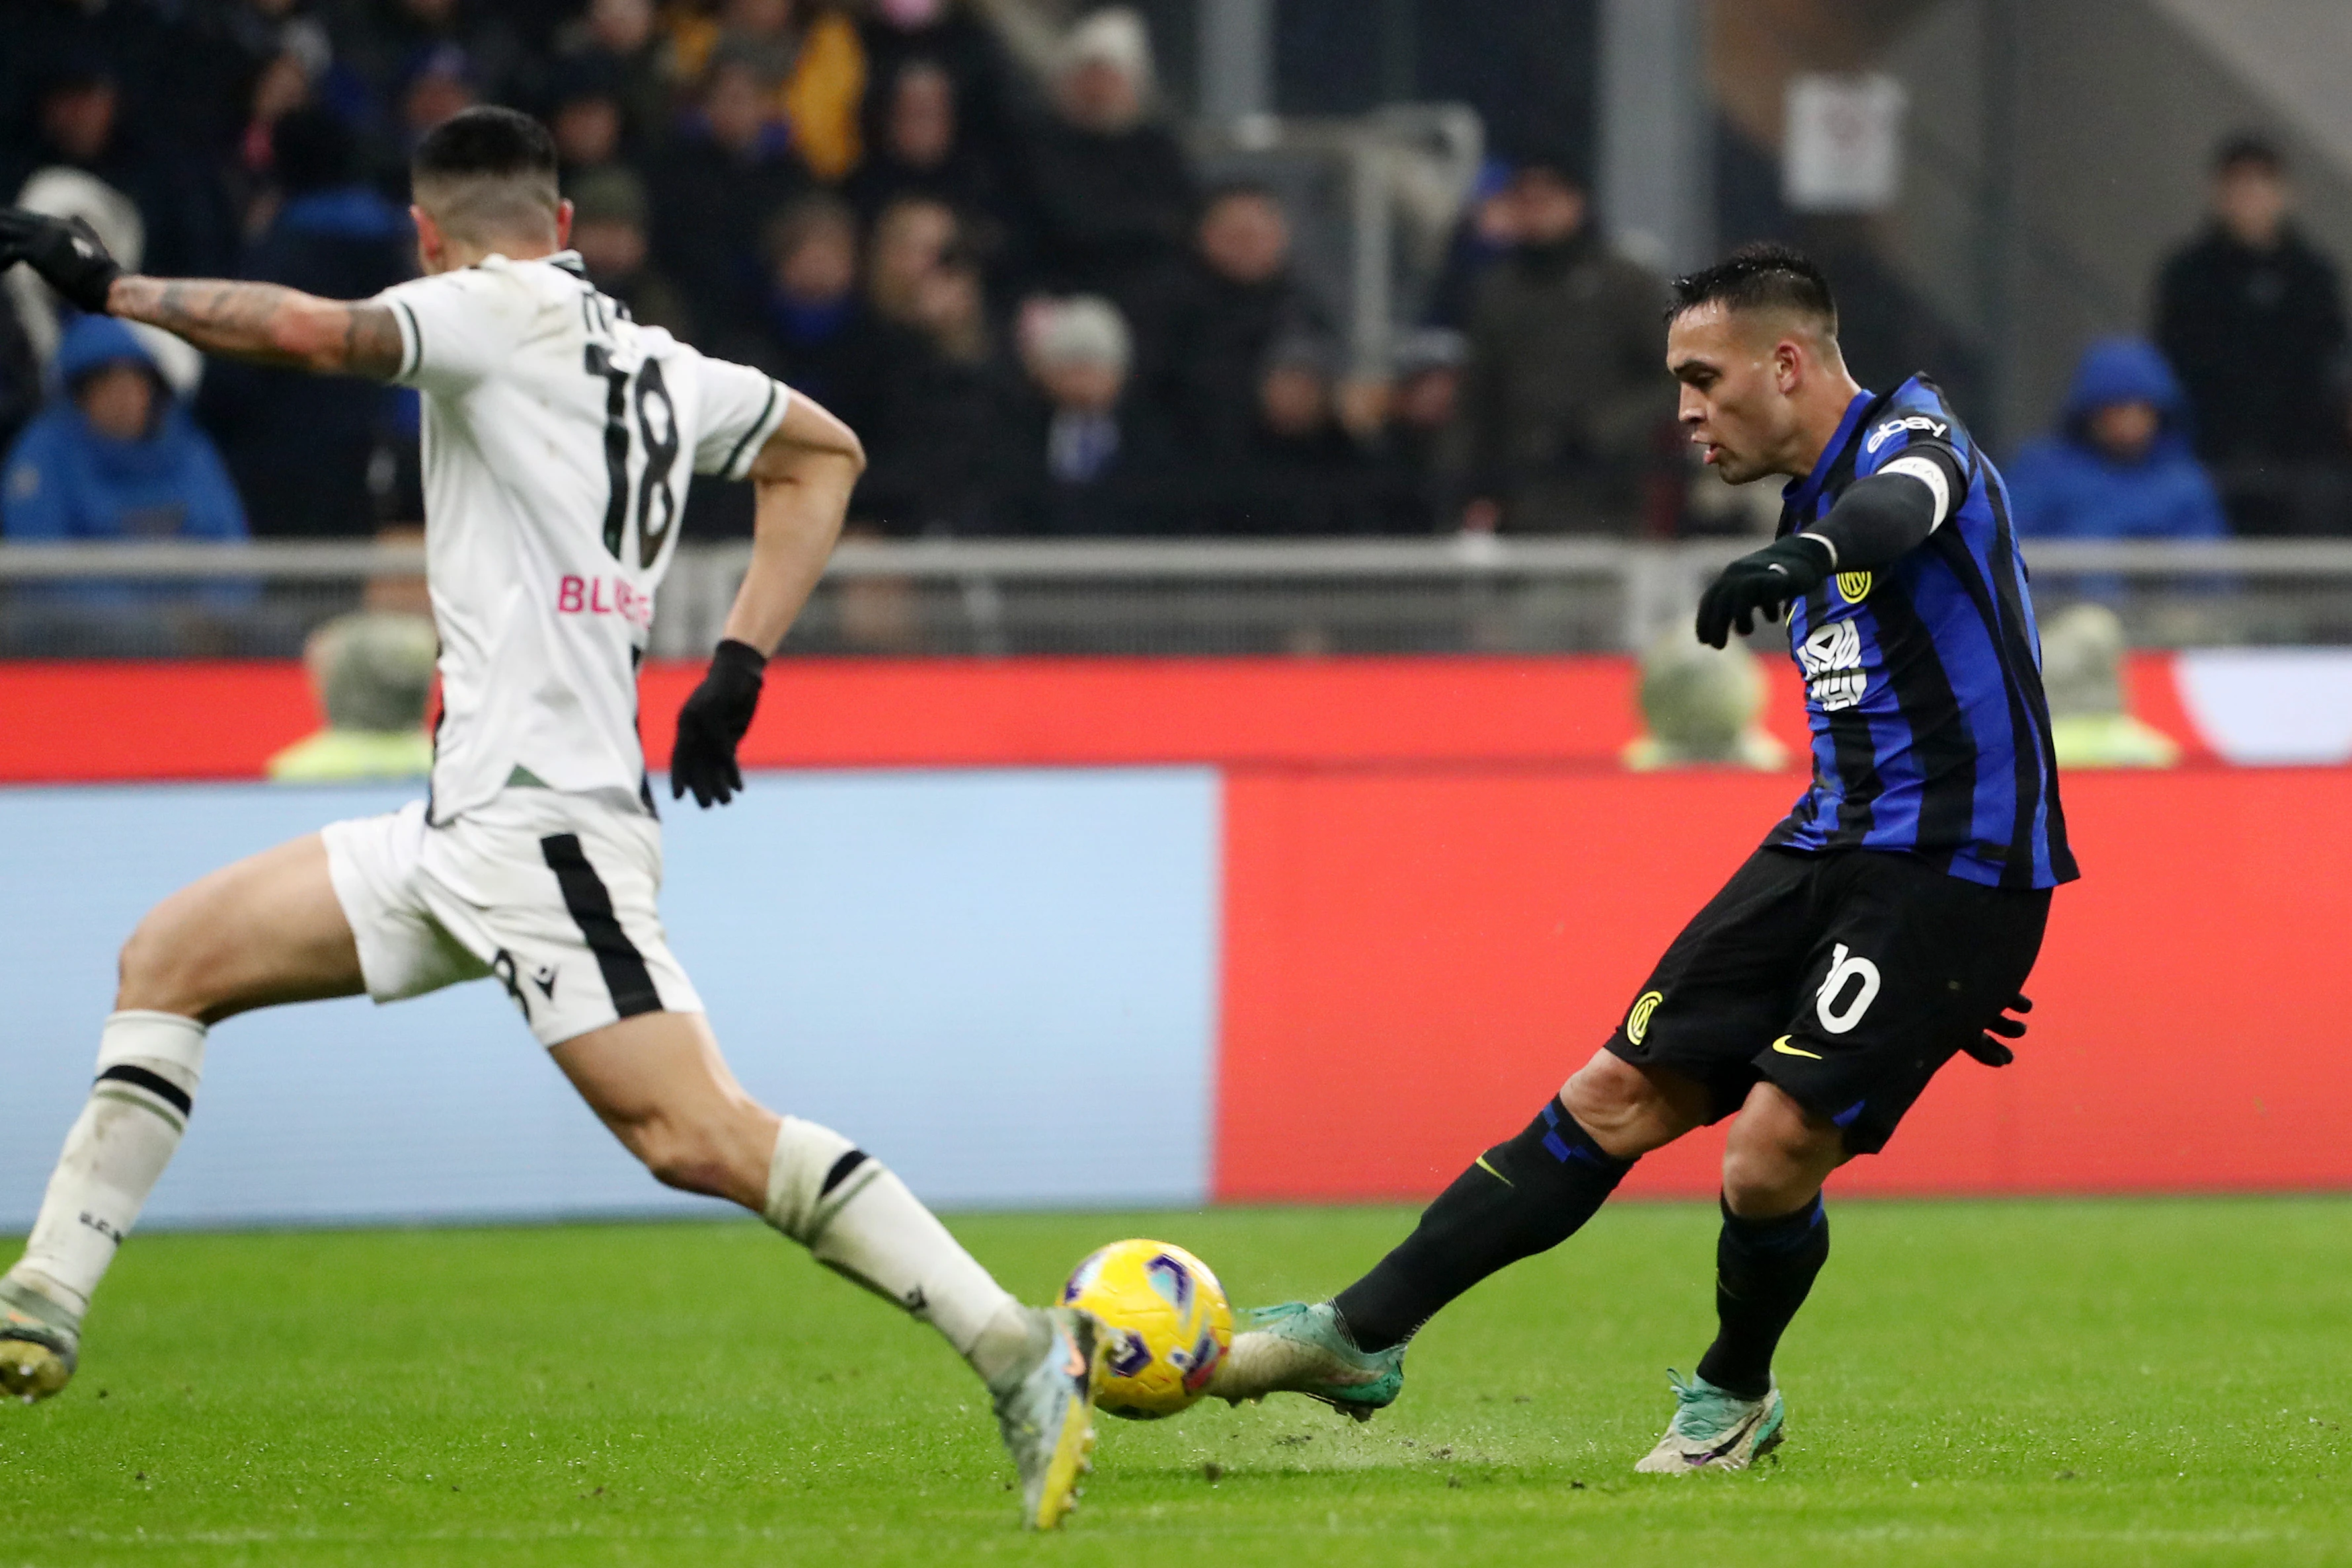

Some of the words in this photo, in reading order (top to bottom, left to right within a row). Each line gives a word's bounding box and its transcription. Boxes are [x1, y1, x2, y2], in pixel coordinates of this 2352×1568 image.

[584, 342, 679, 570] 18
[1867, 416, 1947, 453] ebay
[1816, 943, 1881, 1034] 10
